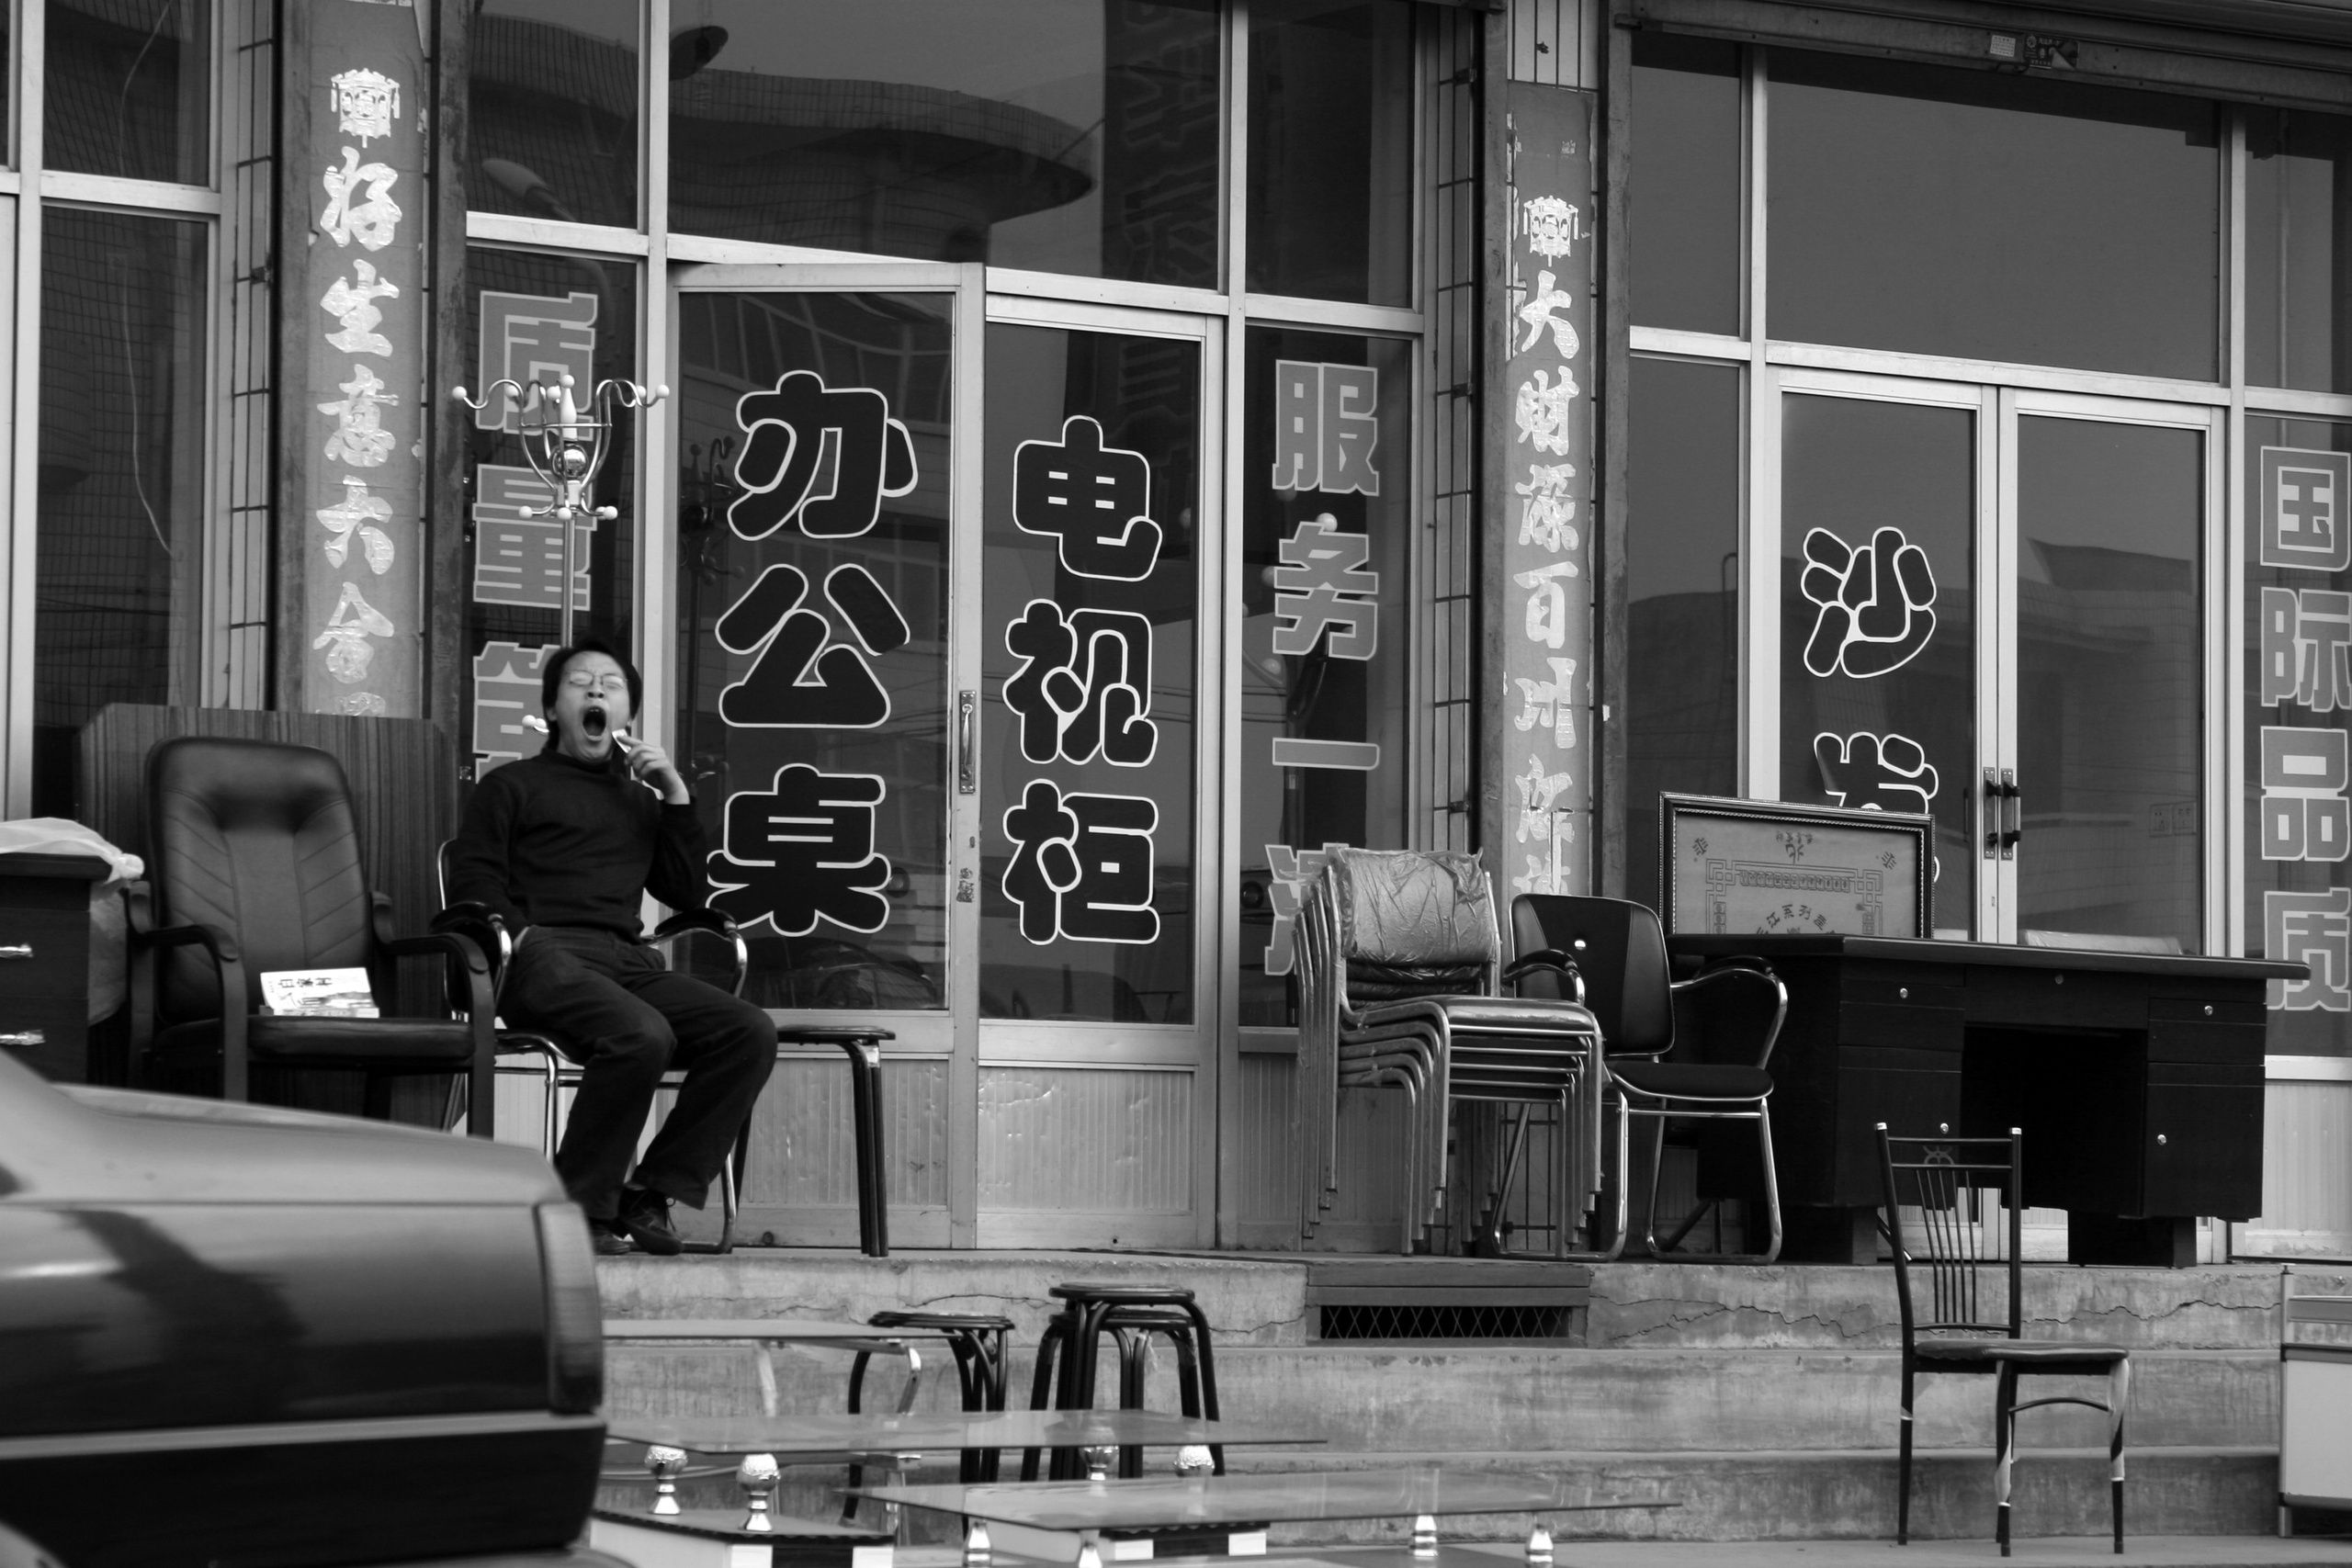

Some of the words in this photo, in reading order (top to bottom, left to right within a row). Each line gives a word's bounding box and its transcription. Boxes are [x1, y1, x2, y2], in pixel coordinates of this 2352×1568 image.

[313, 145, 402, 716] 好生意六合
[707, 370, 919, 938] 办公桌
[1002, 415, 1163, 946] 电视柜
[2260, 446, 2352, 1011] 国际品质
